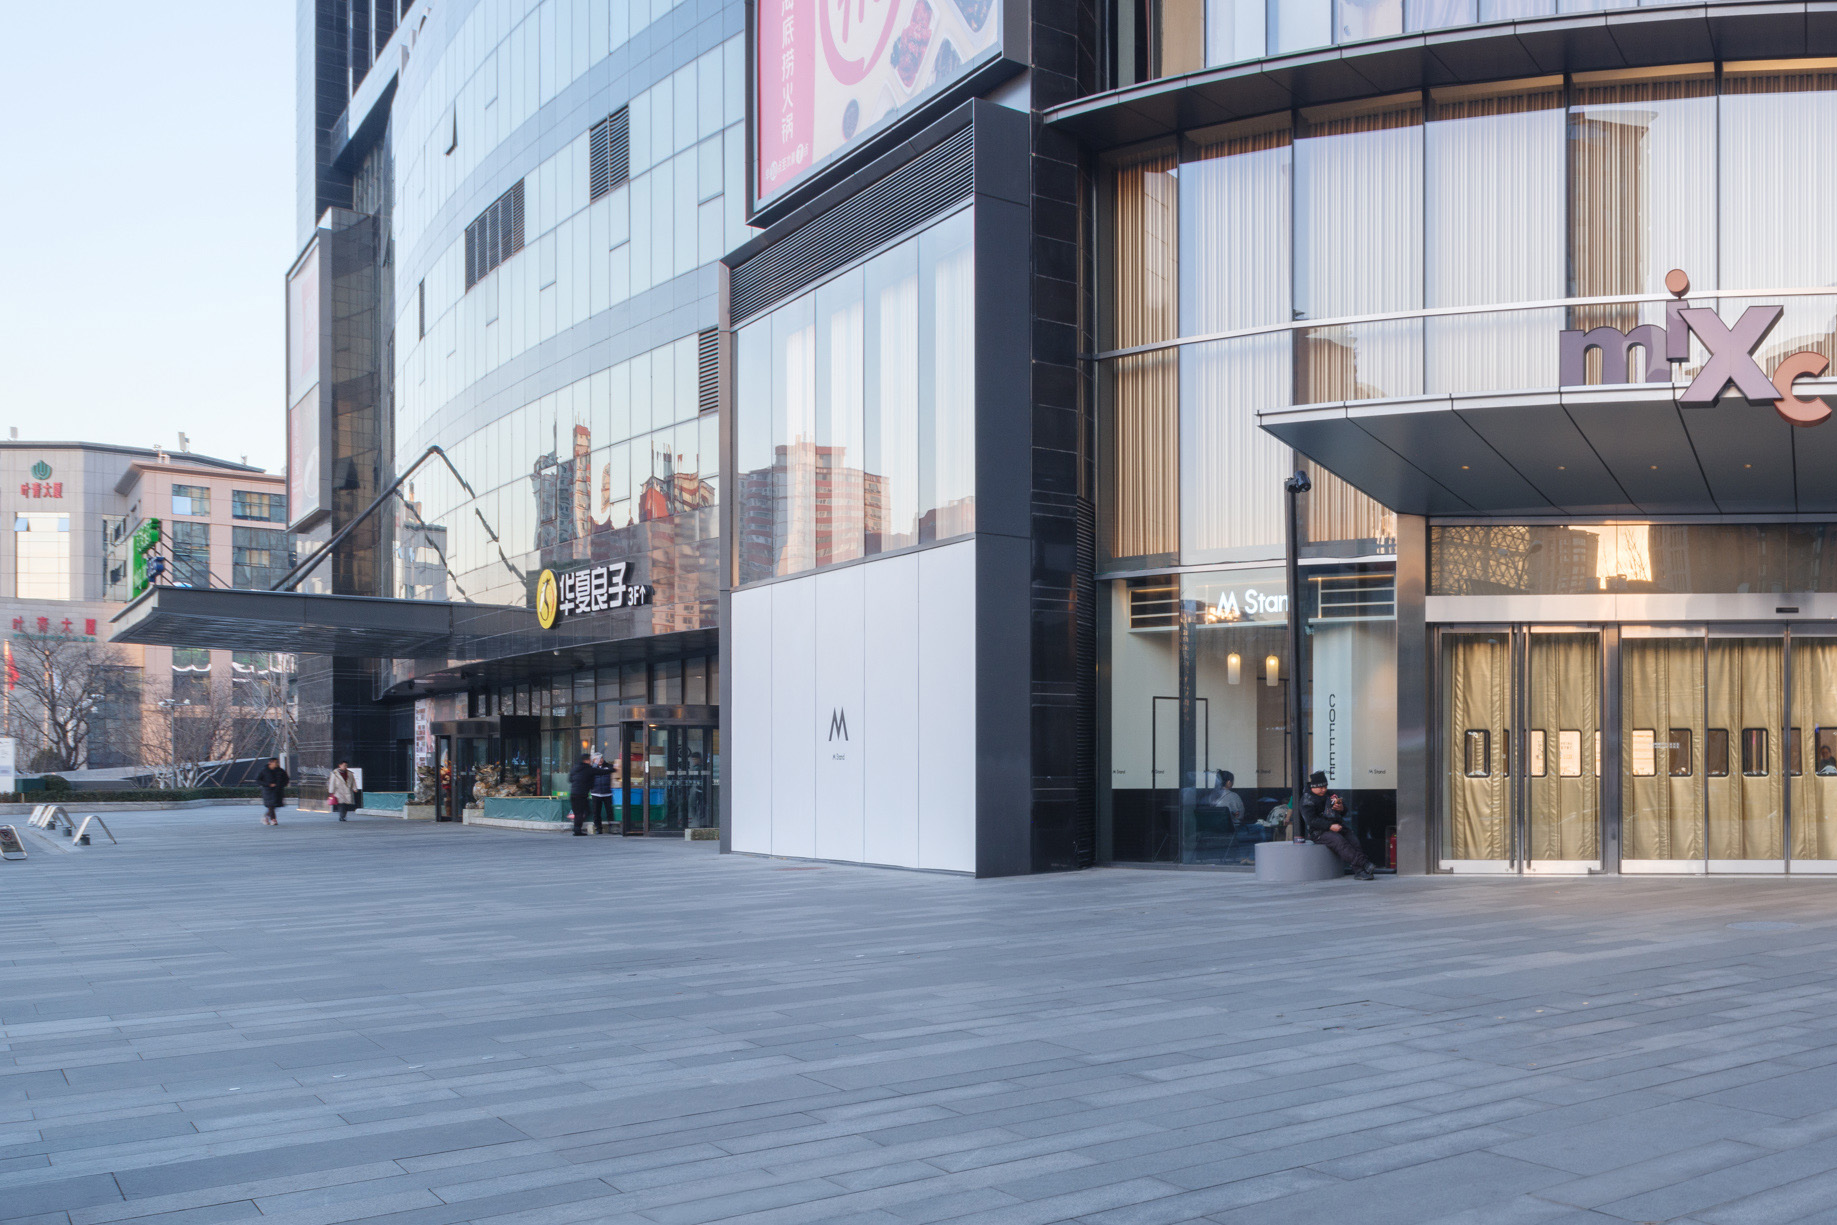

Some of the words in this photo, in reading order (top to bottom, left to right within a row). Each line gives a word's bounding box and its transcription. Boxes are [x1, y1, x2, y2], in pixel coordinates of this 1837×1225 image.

[560, 562, 626, 616] 华夏良子
[627, 585, 639, 606] 3F
[1328, 693, 1336, 781] COFFEE
